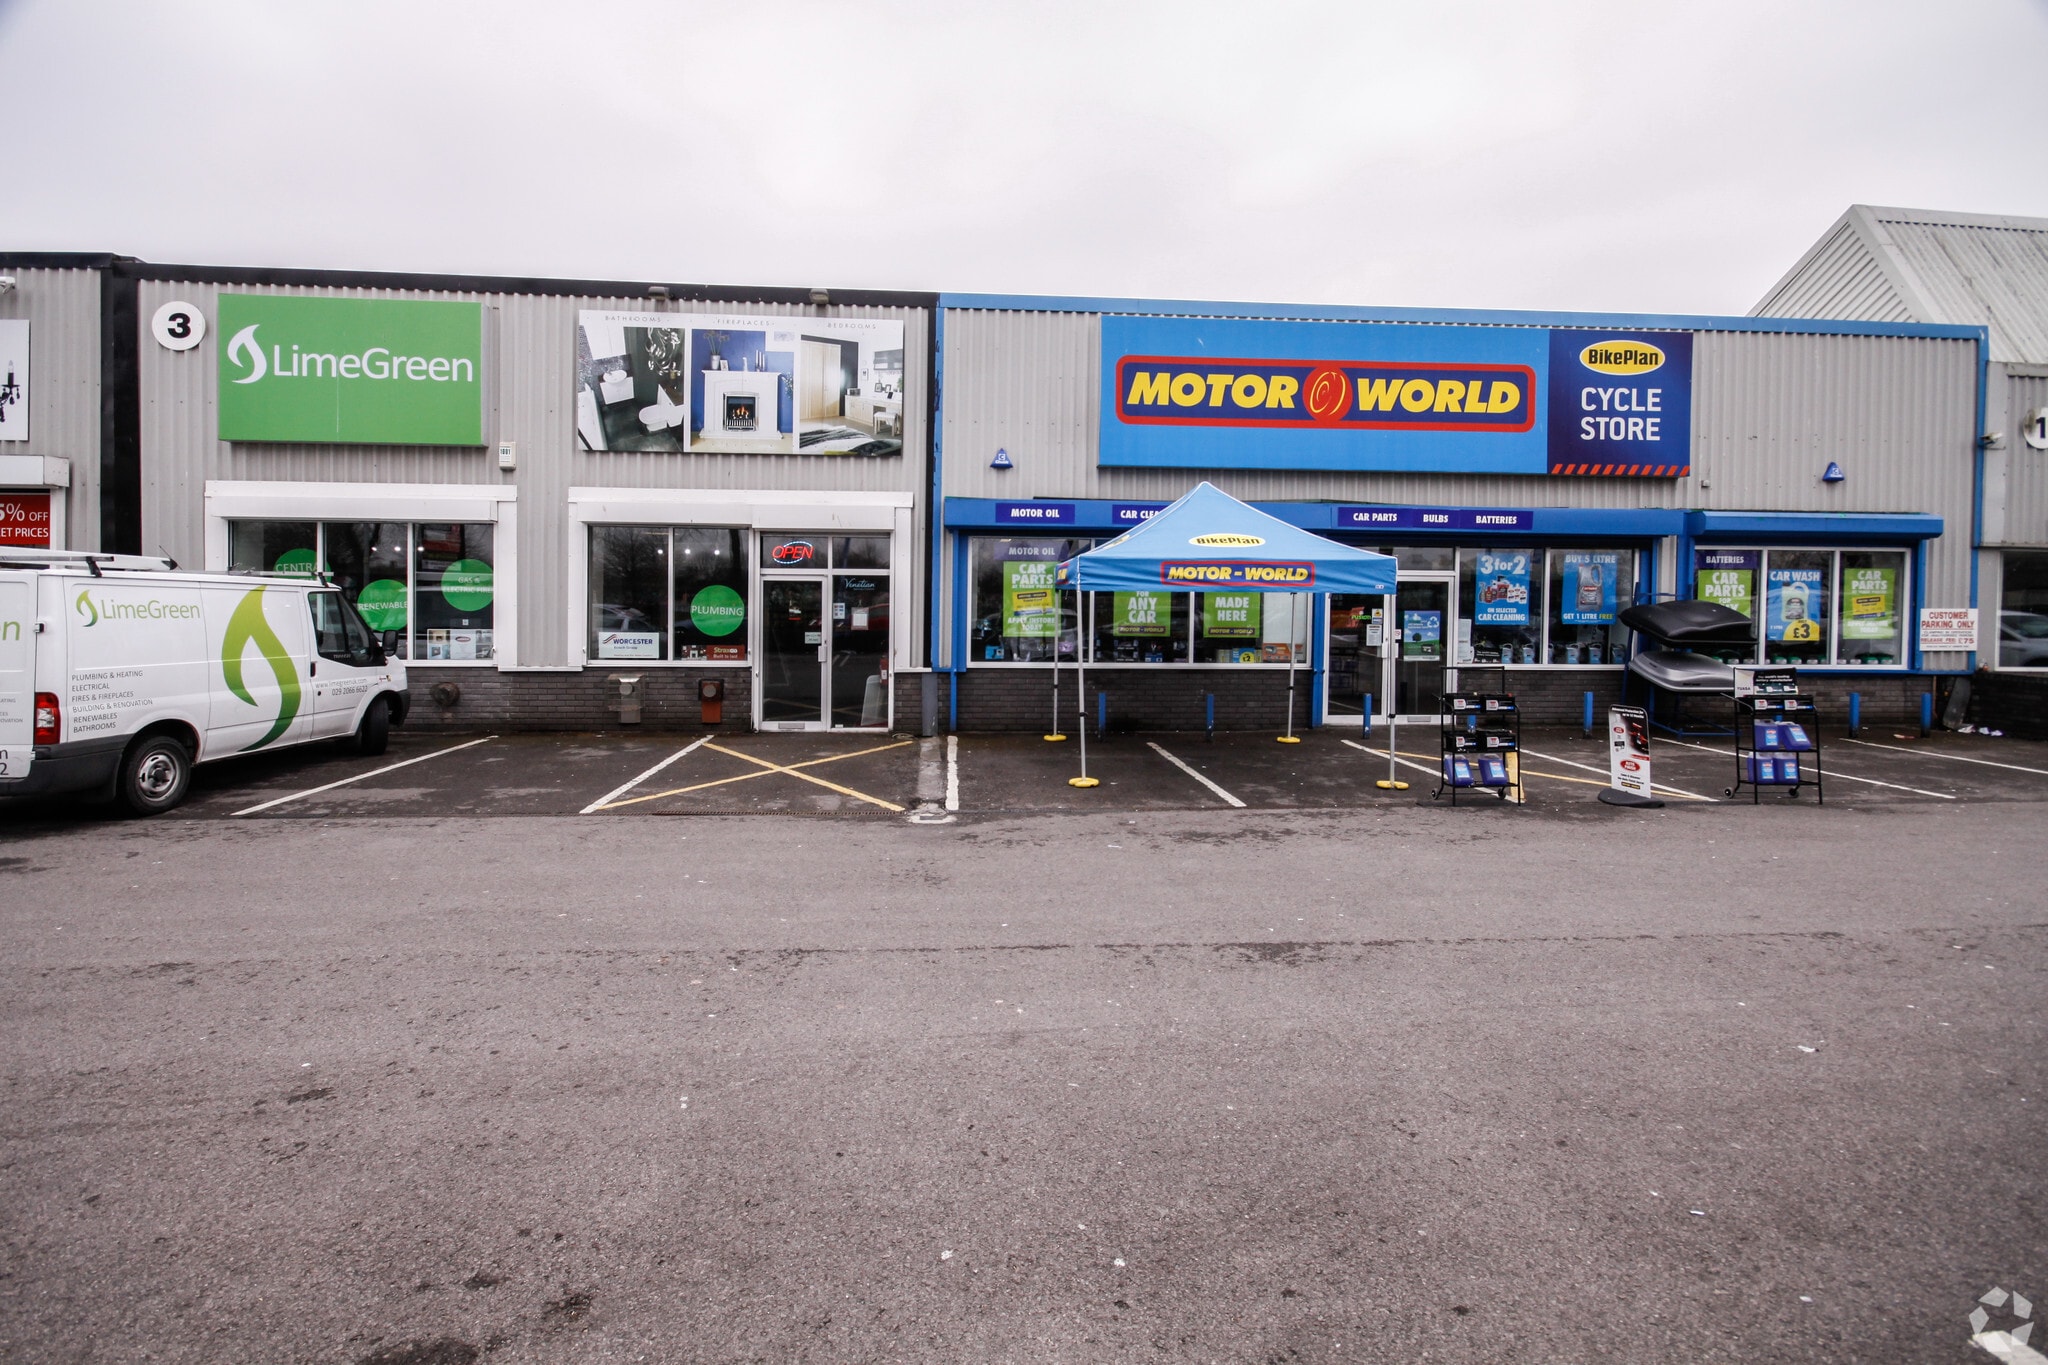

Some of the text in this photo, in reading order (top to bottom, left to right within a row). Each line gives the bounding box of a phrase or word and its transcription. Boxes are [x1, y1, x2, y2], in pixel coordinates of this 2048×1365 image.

[605, 315, 662, 323] BATHROOMS
[717, 318, 771, 326] FIREPLACES
[167, 312, 191, 338] 3
[827, 322, 877, 330] BEDROOMS
[1588, 348, 1659, 366] BikePlan
[273, 344, 473, 382] LimeGreen
[1127, 371, 1521, 413] MOTOR WORLD
[1580, 387, 1662, 412] CYCLE
[1580, 416, 1661, 441] STORE
[2035, 417, 2046, 439] 1
[29, 511, 49, 521] OFF
[1011, 507, 1060, 518] MOTOR OIL
[1120, 510, 1138, 519] CAR
[1353, 512, 1398, 522] CAR PARTS
[1423, 514, 1449, 523] BULBS
[1475, 515, 1517, 525] BATTERIES
[15, 527, 49, 538] PRICES
[1196, 536, 1260, 545] BikePlan
[772, 545, 815, 559] OPEN
[1008, 547, 1056, 555] MOTOR OIL
[1565, 554, 1617, 563] BUY 5 LITRE
[1706, 556, 1745, 564] BATTERIES
[1019, 563, 1047, 574] CAR
[1480, 555, 1526, 575] 3 for 2
[1167, 566, 1231, 580] MOTOR
[1245, 567, 1309, 581] WORLD
[1712, 572, 1739, 584] CAR
[1770, 571, 1820, 581] CAR WASH
[1858, 570, 1882, 580] CAR
[458, 576, 473, 584] GAS
[844, 578, 875, 588] Venetian
[1012, 574, 1053, 584] PARTS
[1851, 580, 1888, 590] PARTS
[1705, 584, 1745, 597] PARTS
[1128, 597, 1158, 610] ANY
[1215, 597, 1249, 608] MADE
[101, 599, 200, 619] LimeGreen
[691, 605, 743, 617] PLUMBING
[1129, 610, 1157, 623] CAR
[1217, 610, 1247, 621] HERE
[1478, 613, 1526, 621] CAR CLEANING
[1929, 611, 1968, 619] CUSTOMER
[1921, 620, 1975, 628] PARKING ONLY
[1793, 623, 1811, 639] £3
[72, 673, 108, 681] PLUMBING
[116, 670, 143, 678] HEATING
[72, 683, 110, 692] ELECTRICAL
[332, 688, 342, 696] 029
[343, 687, 355, 695] 2066
[99, 691, 134, 699] FIREPLACES
[73, 704, 105, 713] BUILDING
[113, 699, 153, 709] RENOVATION
[74, 713, 118, 723] RENEWABLES
[74, 722, 116, 733] BATHROOMS
